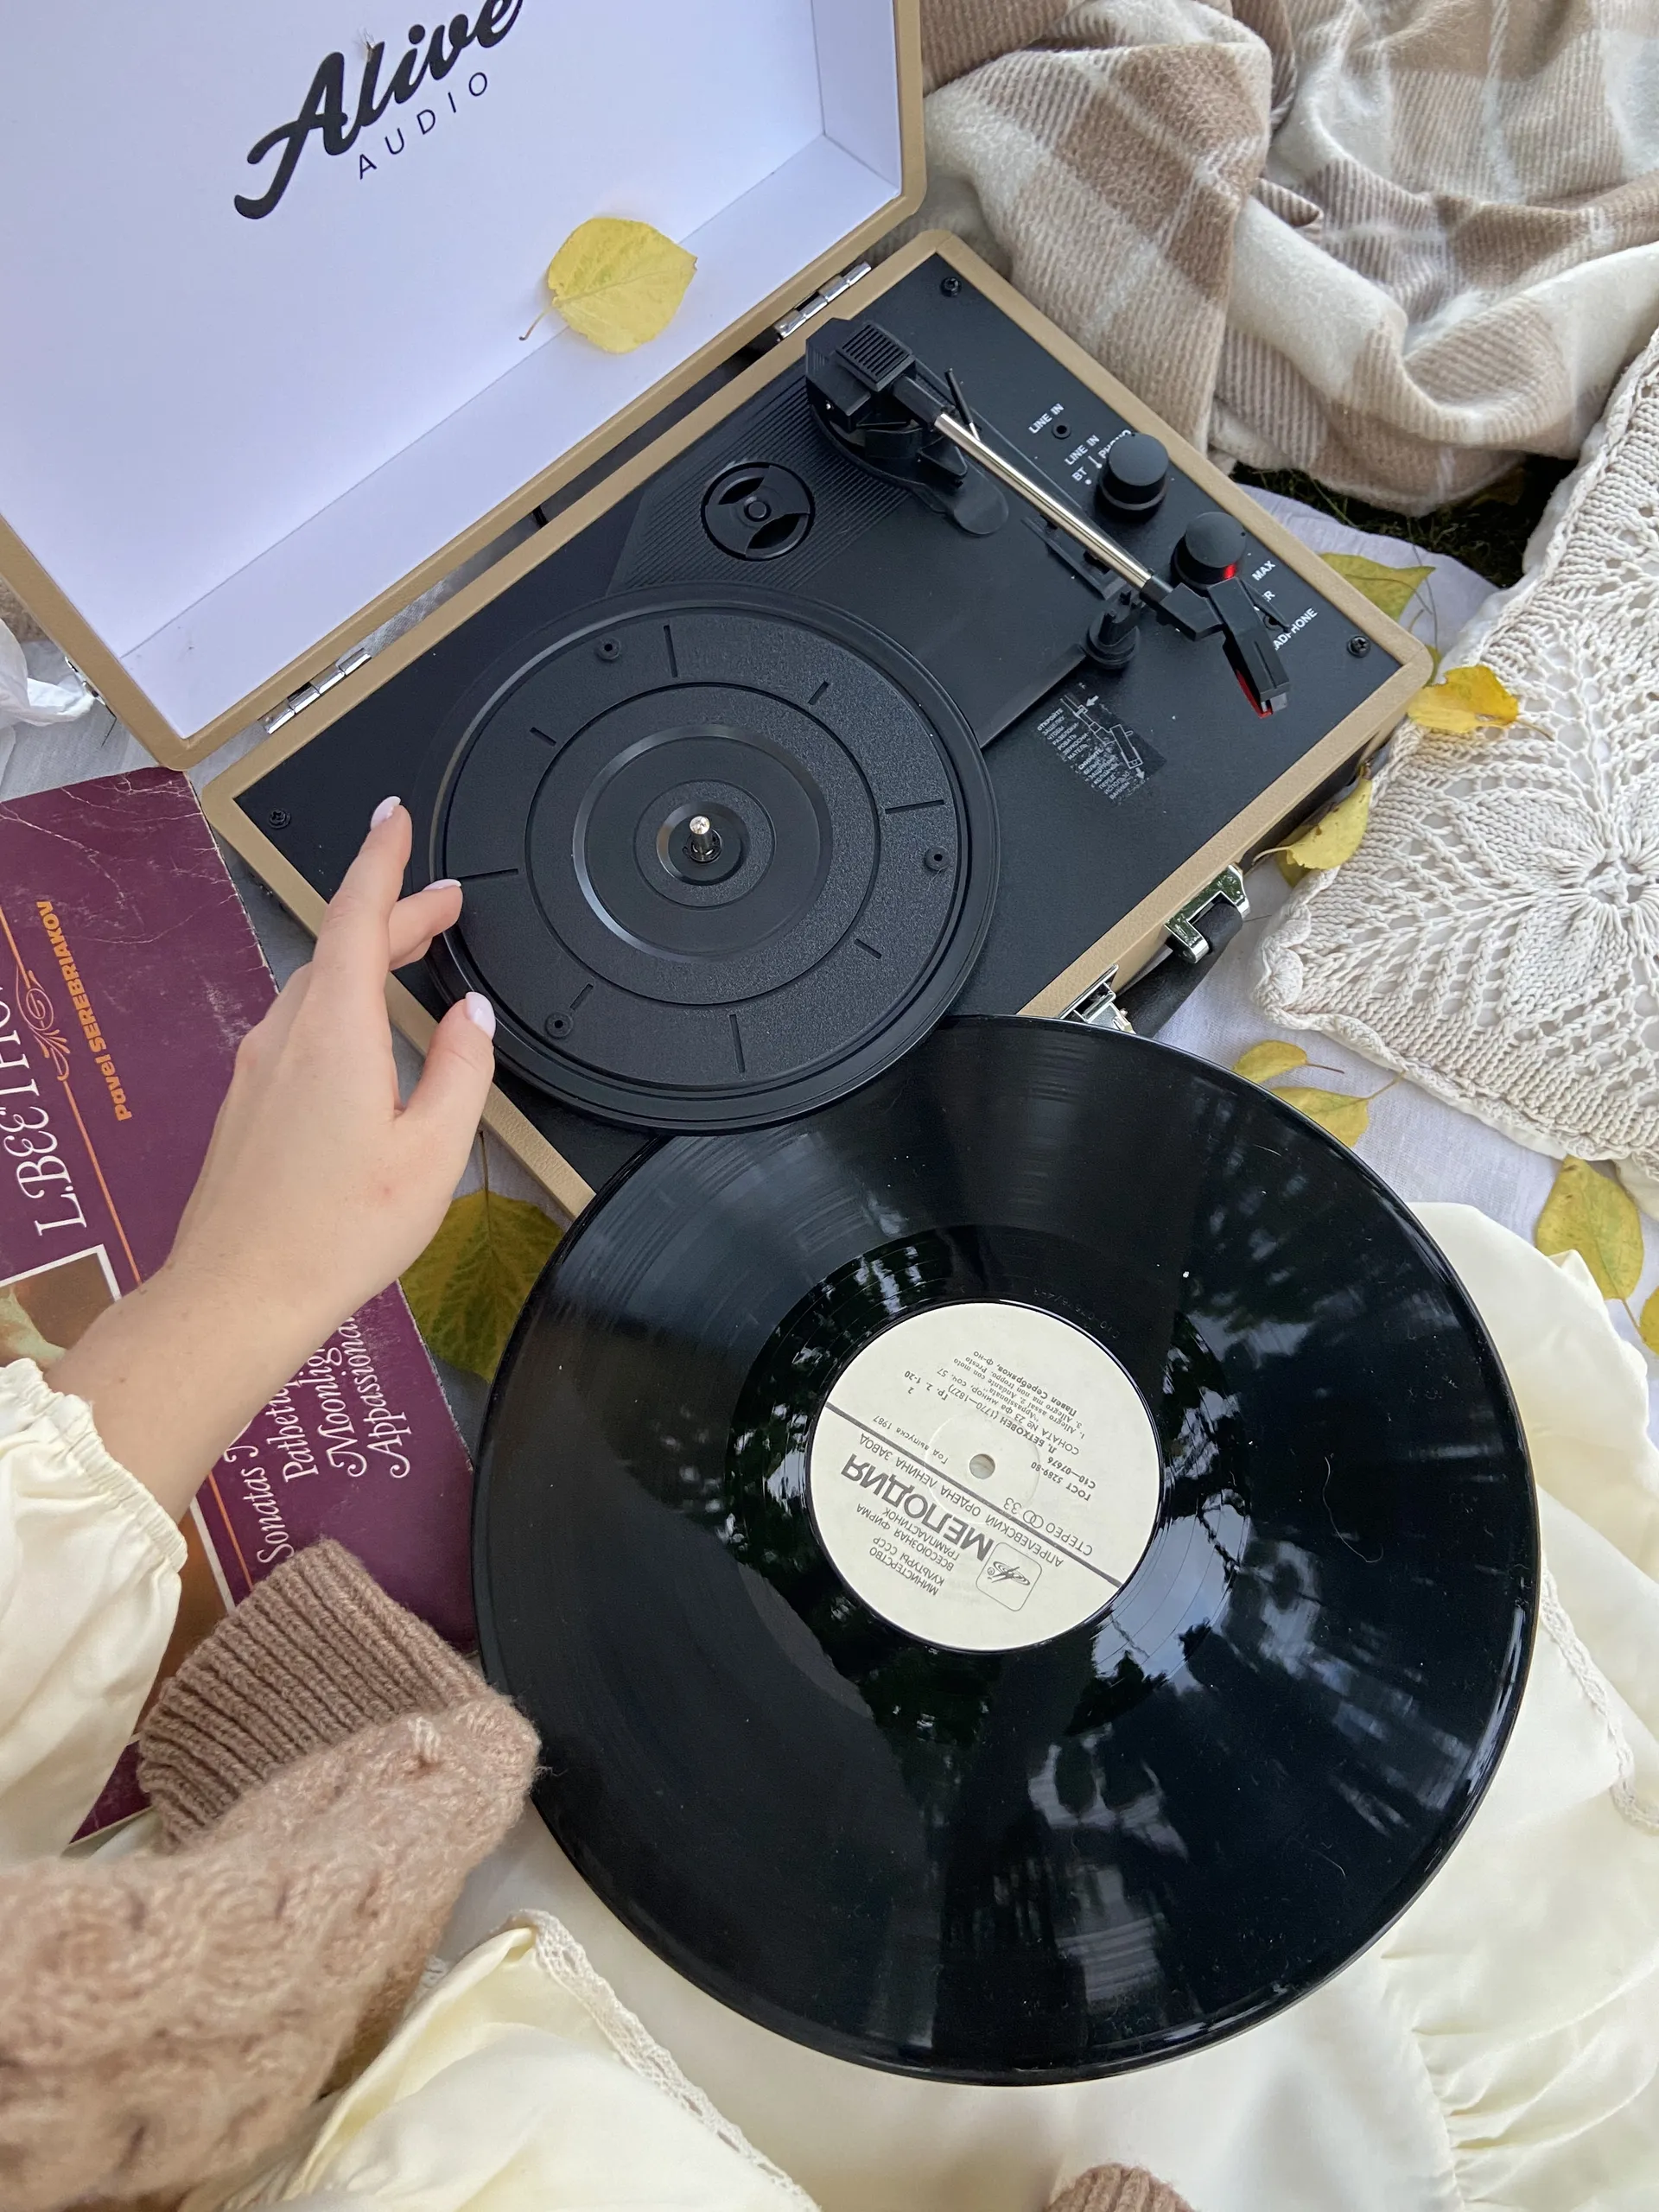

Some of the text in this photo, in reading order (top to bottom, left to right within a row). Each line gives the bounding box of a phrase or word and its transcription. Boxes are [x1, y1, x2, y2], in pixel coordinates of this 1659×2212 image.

[234, 0, 523, 219] Alive
[359, 72, 487, 179] AUDIO
[1028, 403, 1065, 434] LINE IN
[1065, 435, 1100, 466] LINE IN
[1071, 467, 1087, 481] BT
[1251, 560, 1276, 581] MAX
[35, 900, 132, 1122] Pavel SEREBRIAKOV
[904, 1370, 921, 1384] 1-20
[953, 1358, 971, 1371] moto
[965, 1357, 988, 1374] Presto
[973, 1370, 986, 1380] con
[937, 1389, 949, 1401] Гр.
[973, 1351, 1077, 1417] Павел Серебряков, ф-но
[988, 1378, 1017, 1399] Andante
[1016, 1387, 1030, 1397] non
[937, 1368, 1079, 1455] СОНАТА № 23 фа минор, соч. 57
[1033, 1396, 1044, 1406] ma
[1046, 1404, 1073, 1423] Allegro
[1000, 1416, 1046, 1447] БЕТХОВЕН
[1049, 1414, 1077, 1434] Allegro
[873, 1415, 949, 1465] Год выпуска 1987
[1048, 1444, 1057, 1454] Л.
[1031, 1462, 1091, 1502] ГОСТ 5289-80
[241, 1466, 295, 1563] Sonatas
[841, 1453, 995, 1562] МЕЛОДИЯ
[860, 1433, 1064, 1567] АПРЕЛЕВСКИЙ ОРДЕНА ЛЕНИНА ЗАВОД
[856, 1503, 955, 1572] ВСЕСОЮЗНАЯ ФИРМА
[882, 1507, 960, 1561] ГРАМПЛАСТИНОК
[1003, 1497, 1093, 1556] СТЕРЕО 33
[869, 1547, 939, 1596] МИНИСТЕРСТВО
[873, 1537, 945, 1586] КУЛЬТУРЫ СССР
